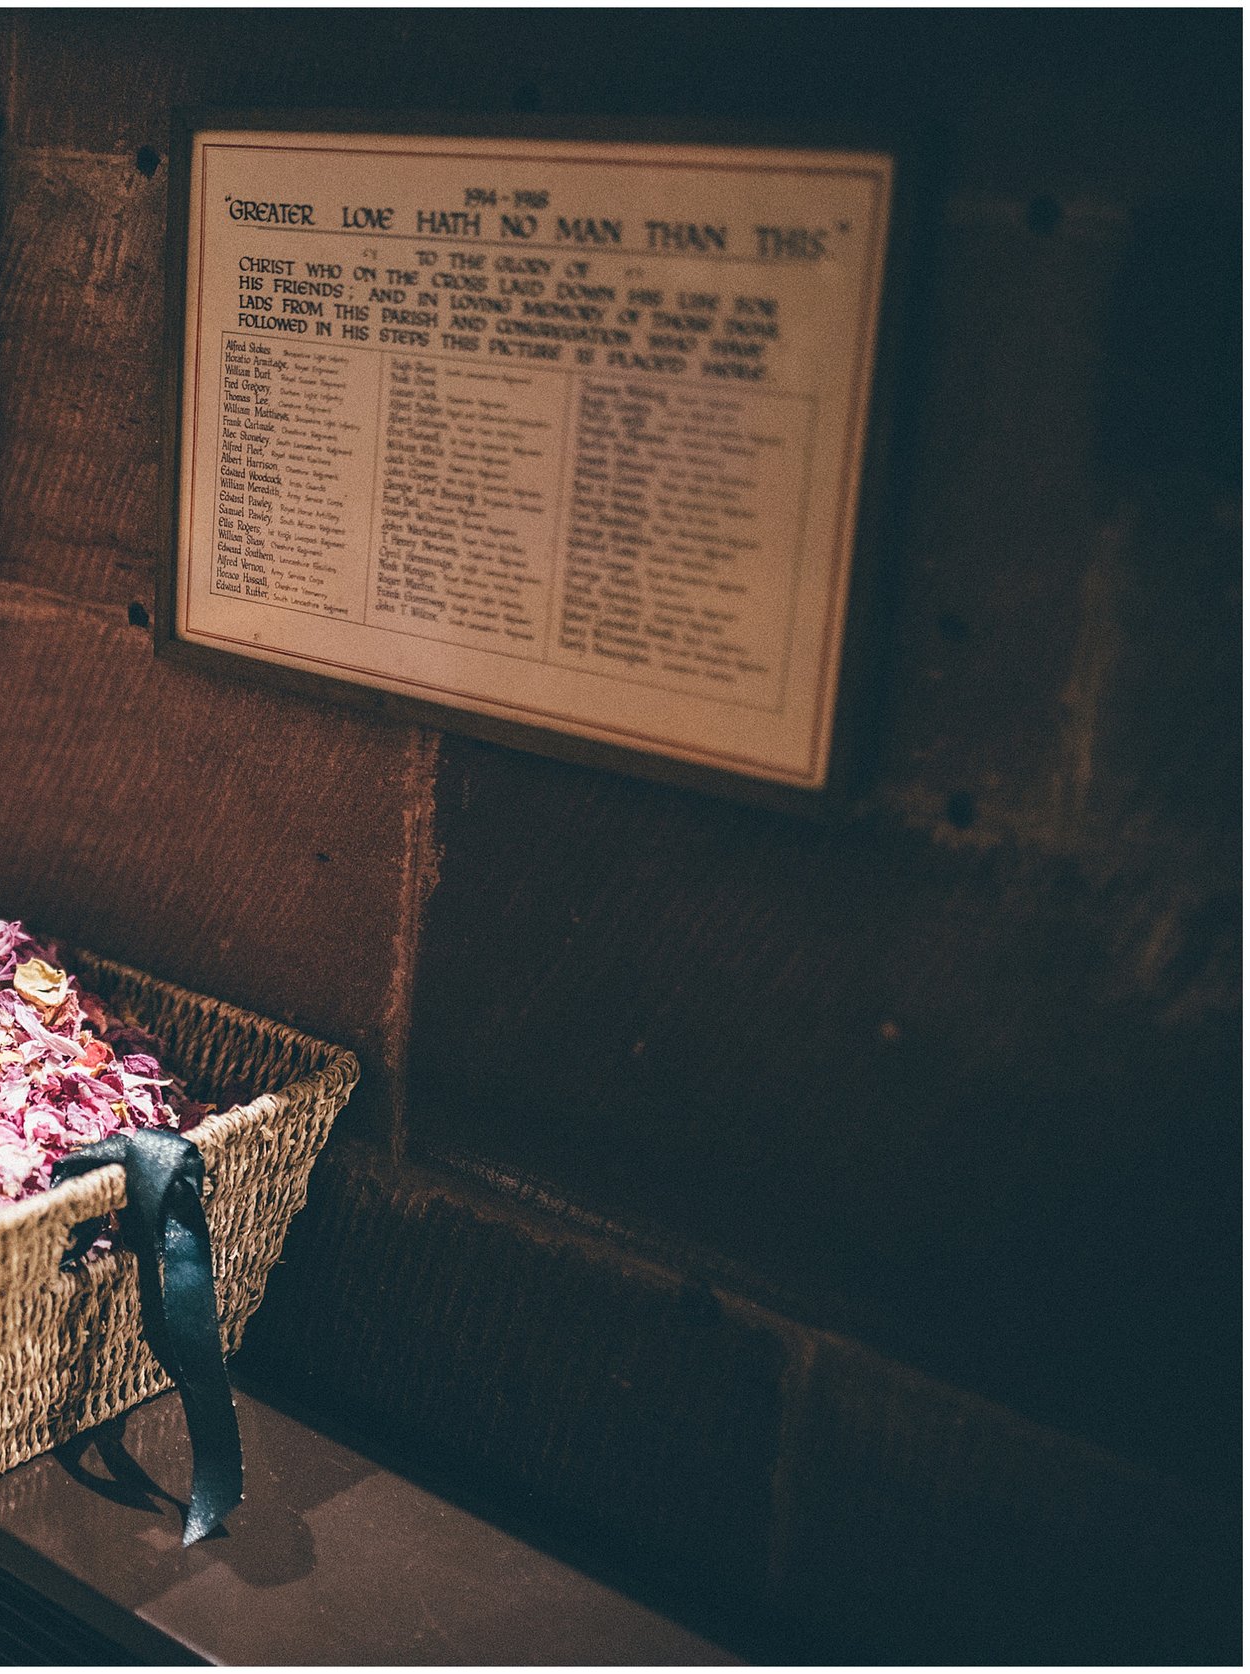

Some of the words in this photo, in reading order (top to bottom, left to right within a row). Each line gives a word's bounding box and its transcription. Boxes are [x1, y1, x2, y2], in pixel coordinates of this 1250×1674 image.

[341, 206, 395, 230] LOVE
[416, 210, 481, 236] HATH
[500, 214, 538, 239] NO
[555, 216, 622, 244] MAN
[643, 220, 727, 253] THAN
[414, 249, 438, 266] TO
[447, 252, 487, 270] THE
[238, 256, 296, 276] CHRIST
[305, 262, 342, 279] WHO
[352, 266, 377, 282] ON
[385, 268, 419, 286] THE
[431, 272, 488, 293] CROSS
[498, 278, 545, 298] LAID
[556, 282, 616, 303] DOWN
[239, 275, 263, 291] HIS
[368, 287, 406, 305] AND
[418, 291, 438, 307] IN
[449, 294, 512, 314] LOVING
[522, 300, 605, 323] MEMORY
[617, 308, 640, 326] OF
[238, 294, 273, 312] LADS
[282, 298, 324, 317] FROM
[333, 303, 370, 322] THIS
[381, 307, 438, 328] PARISH
[449, 314, 487, 332] AND
[495, 318, 632, 347] CONGREGATION
[238, 312, 308, 334] FOLLOWED
[315, 321, 332, 337] IN
[342, 324, 370, 341] HIS
[378, 327, 430, 348] STEPS
[440, 333, 480, 353] THIS
[488, 338, 562, 362] PICTURE
[225, 339, 246, 354] Alfred
[224, 351, 251, 364] Horatio
[224, 364, 250, 377] William
[224, 376, 238, 390] Fred
[224, 389, 251, 403] Thomas
[223, 402, 250, 415] William
[222, 415, 241, 427] Frank
[222, 427, 236, 438] Alec
[222, 439, 243, 453] Alfred
[220, 451, 242, 465] Albert
[220, 464, 246, 479] Edward
[220, 477, 244, 490] William
[218, 489, 244, 504] Edward
[218, 502, 245, 517] Samuel
[218, 516, 234, 529] Ellis
[218, 528, 243, 542] William
[217, 541, 242, 555] Edward
[216, 553, 238, 569] Alfred
[216, 567, 240, 581] Horace
[215, 579, 241, 594] Edward
